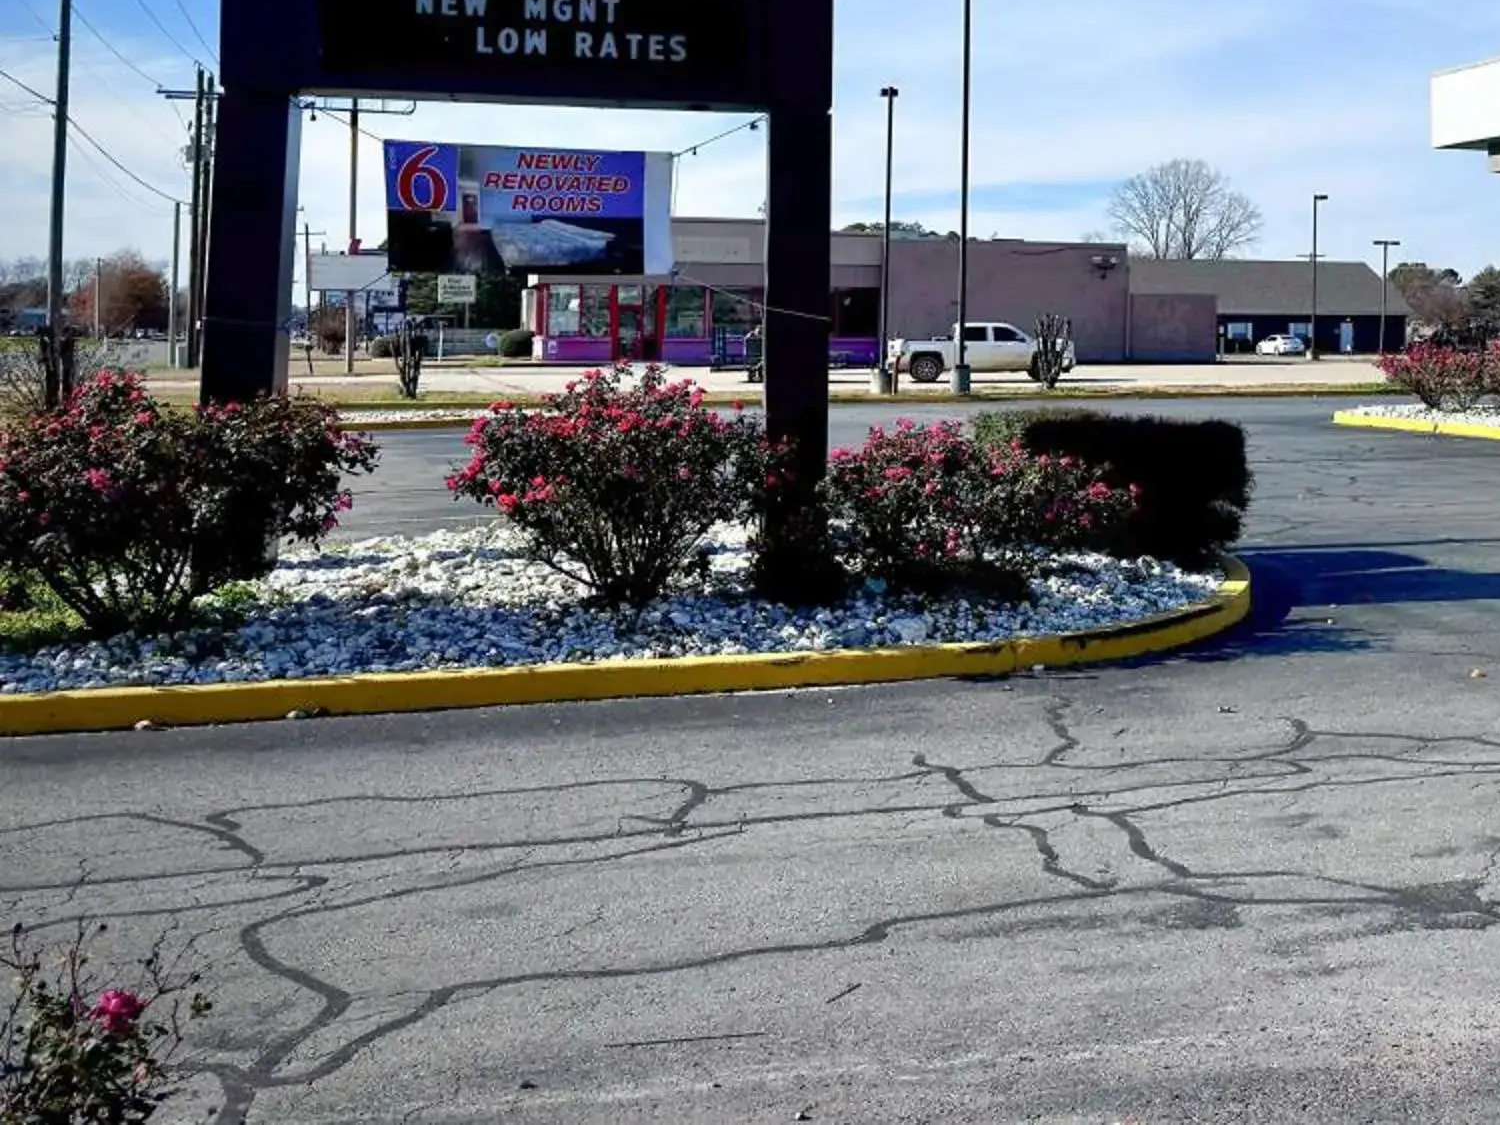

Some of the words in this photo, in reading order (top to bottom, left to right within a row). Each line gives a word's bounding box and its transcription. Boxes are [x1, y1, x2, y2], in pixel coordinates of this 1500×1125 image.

[476, 27, 547, 56] LOW
[575, 31, 687, 62] RATES
[516, 153, 601, 172] NEWLY
[396, 146, 448, 211] 6
[484, 173, 631, 193] RENOVATED
[511, 194, 604, 212] ROOMS
